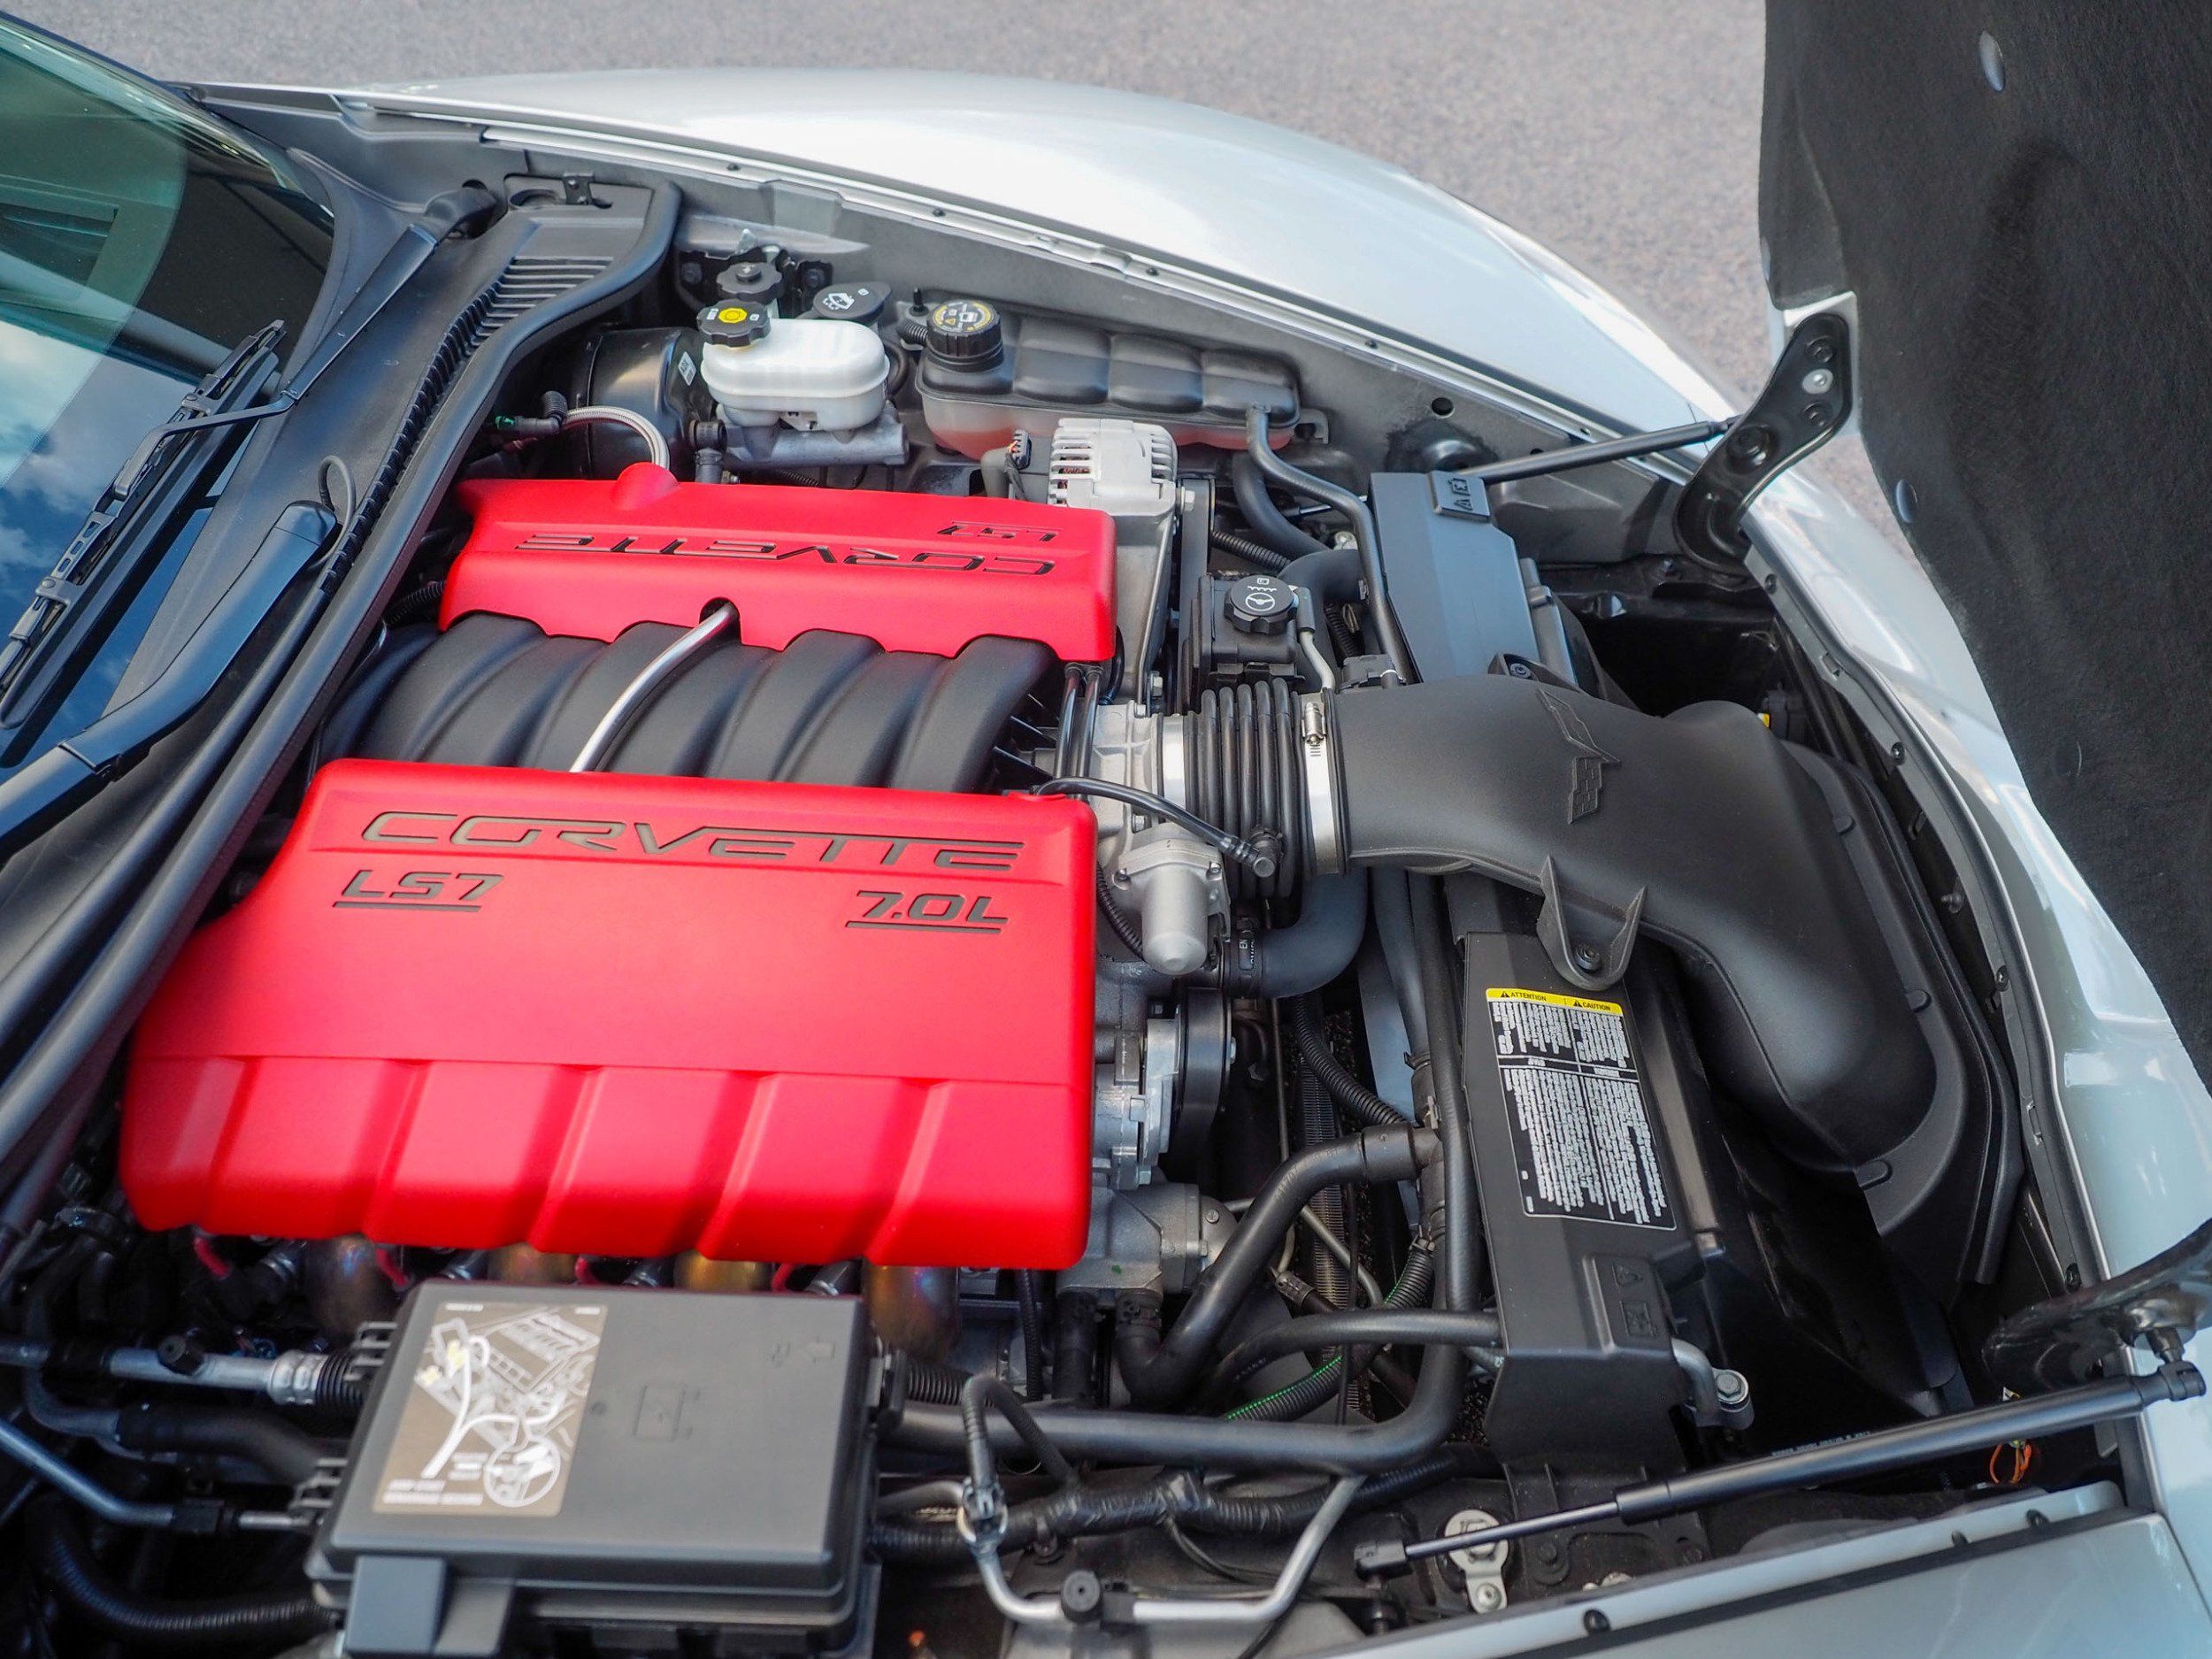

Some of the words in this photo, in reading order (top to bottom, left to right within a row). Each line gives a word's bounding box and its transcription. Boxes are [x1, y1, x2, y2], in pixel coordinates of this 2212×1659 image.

[937, 525, 1058, 541] LS7
[515, 534, 1056, 574] CORVETTE
[361, 810, 1025, 871] CORVETTE
[342, 869, 503, 901] LS7
[857, 890, 1009, 924] 7.0L
[1510, 992, 1547, 1002] ATTENTION
[1582, 1002, 1611, 1011] CAUTION
